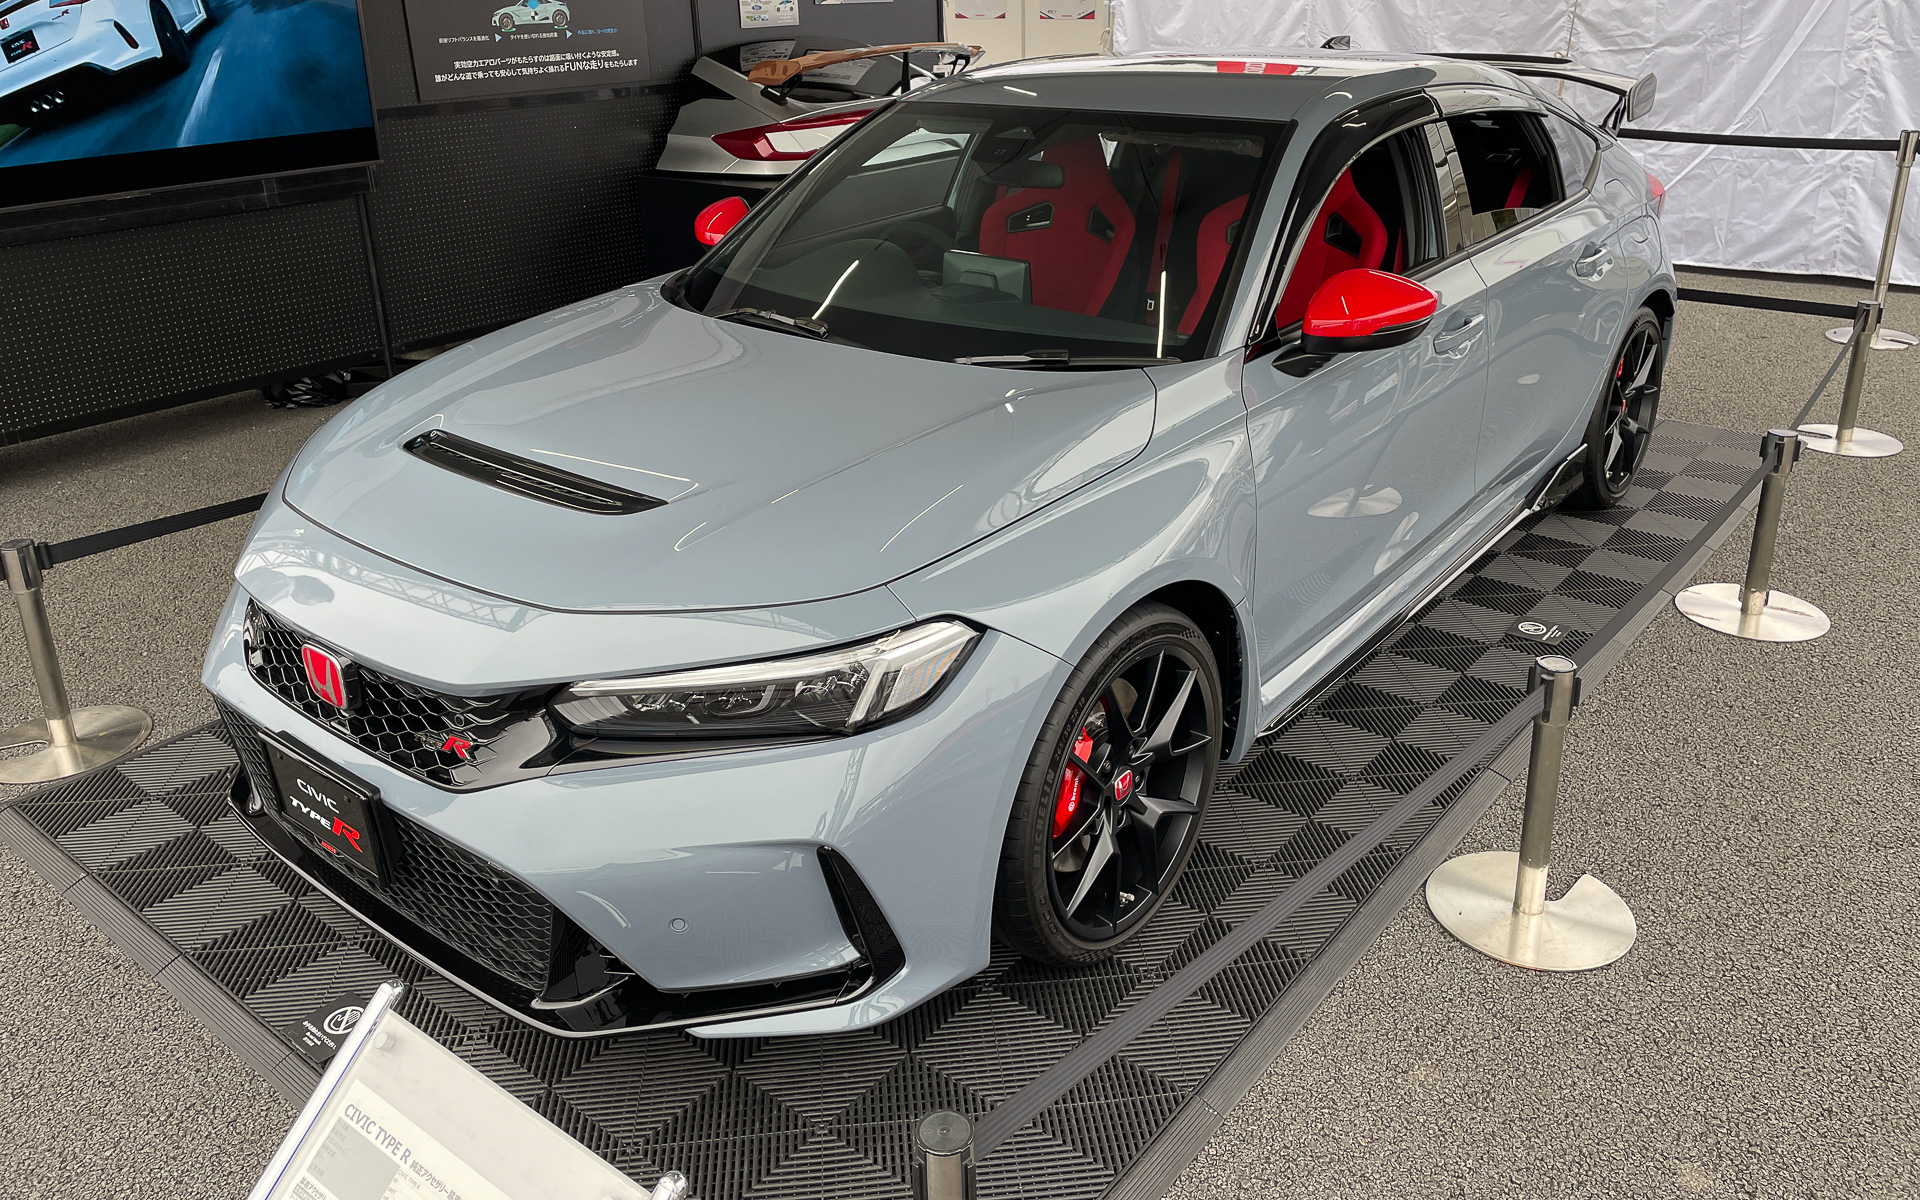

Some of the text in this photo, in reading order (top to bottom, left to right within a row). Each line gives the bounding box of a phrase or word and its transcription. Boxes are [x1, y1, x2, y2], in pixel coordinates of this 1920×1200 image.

[289, 795, 364, 854] TYPE R
[296, 778, 339, 814] CIVIC
[344, 1103, 377, 1135] CIVIC
[374, 1126, 403, 1157] TYPE
[399, 1148, 412, 1165] R
